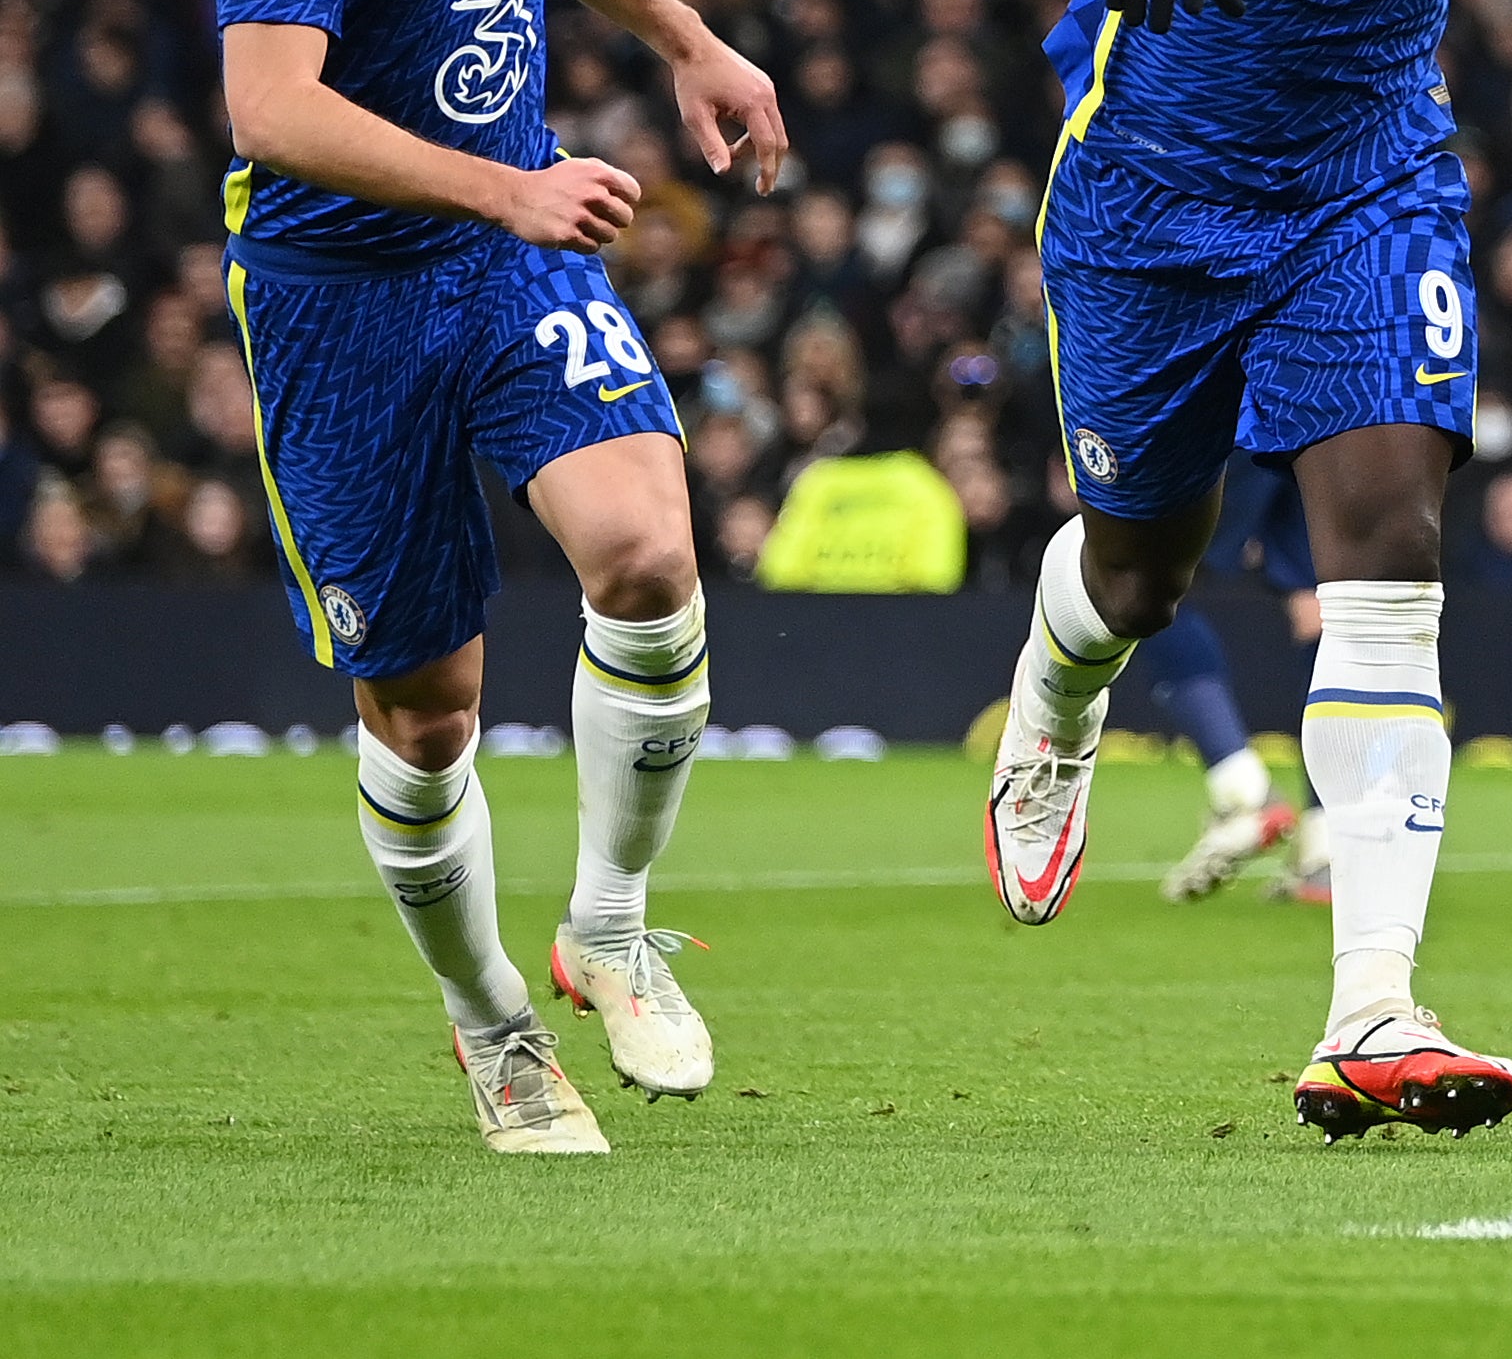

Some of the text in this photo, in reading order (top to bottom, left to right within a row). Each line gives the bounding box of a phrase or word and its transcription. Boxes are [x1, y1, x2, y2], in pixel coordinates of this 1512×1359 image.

[535, 300, 652, 390] 28
[1419, 269, 1464, 360] 9
[1410, 793, 1445, 813] CF
